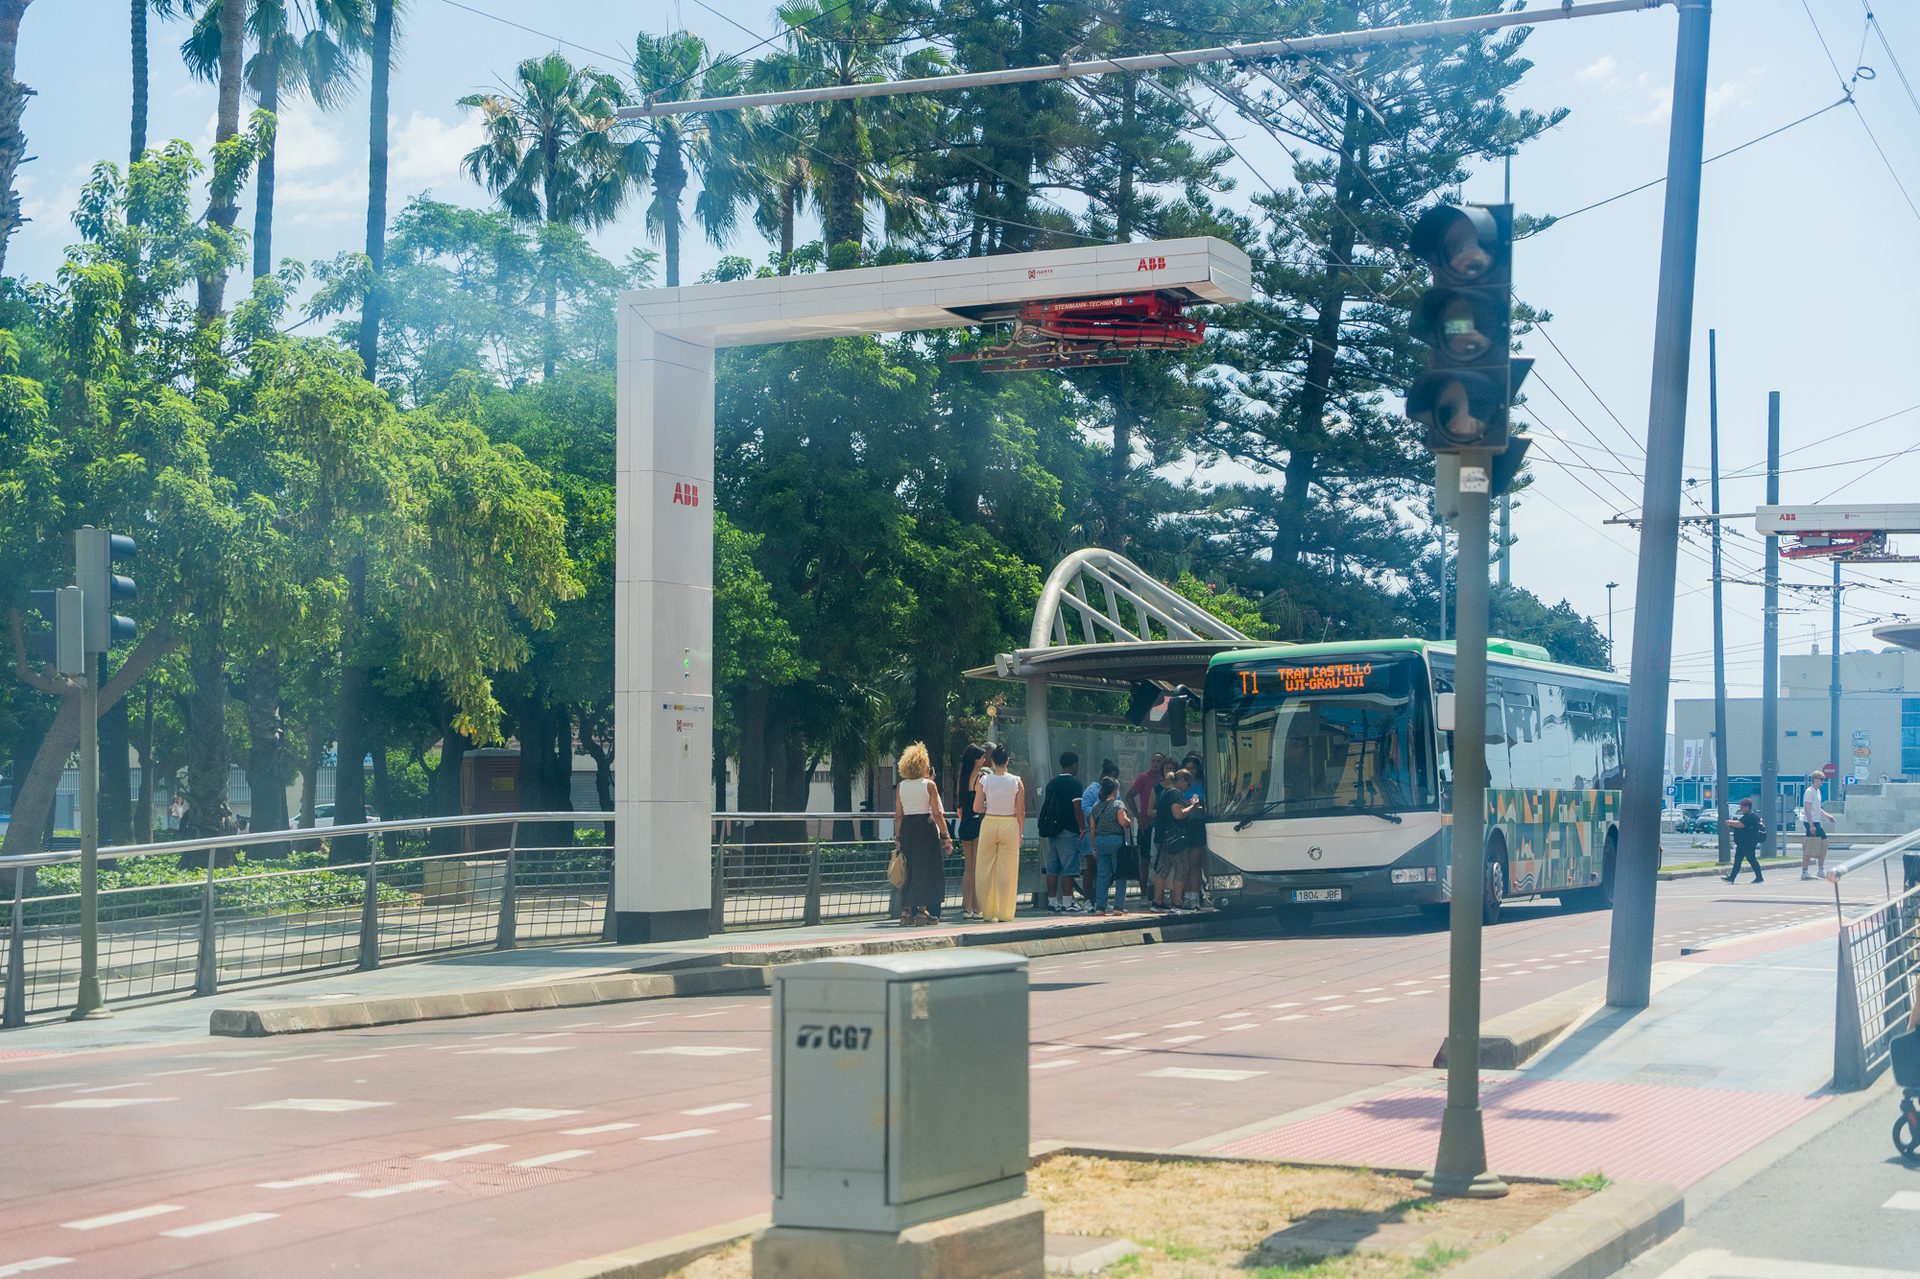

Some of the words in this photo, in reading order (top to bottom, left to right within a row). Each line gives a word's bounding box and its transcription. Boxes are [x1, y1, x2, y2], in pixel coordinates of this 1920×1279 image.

[1137, 256, 1167, 272] ABB
[673, 481, 699, 508] ABB
[1779, 513, 1797, 521] ABB
[1277, 667, 1310, 680] TRAM
[1312, 663, 1372, 678] CASTELLÓ
[1239, 671, 1259, 695] T1
[1285, 675, 1365, 692] UJI-GRAU-UJI
[1298, 890, 1319, 900] 1804
[1324, 889, 1340, 899] JBF
